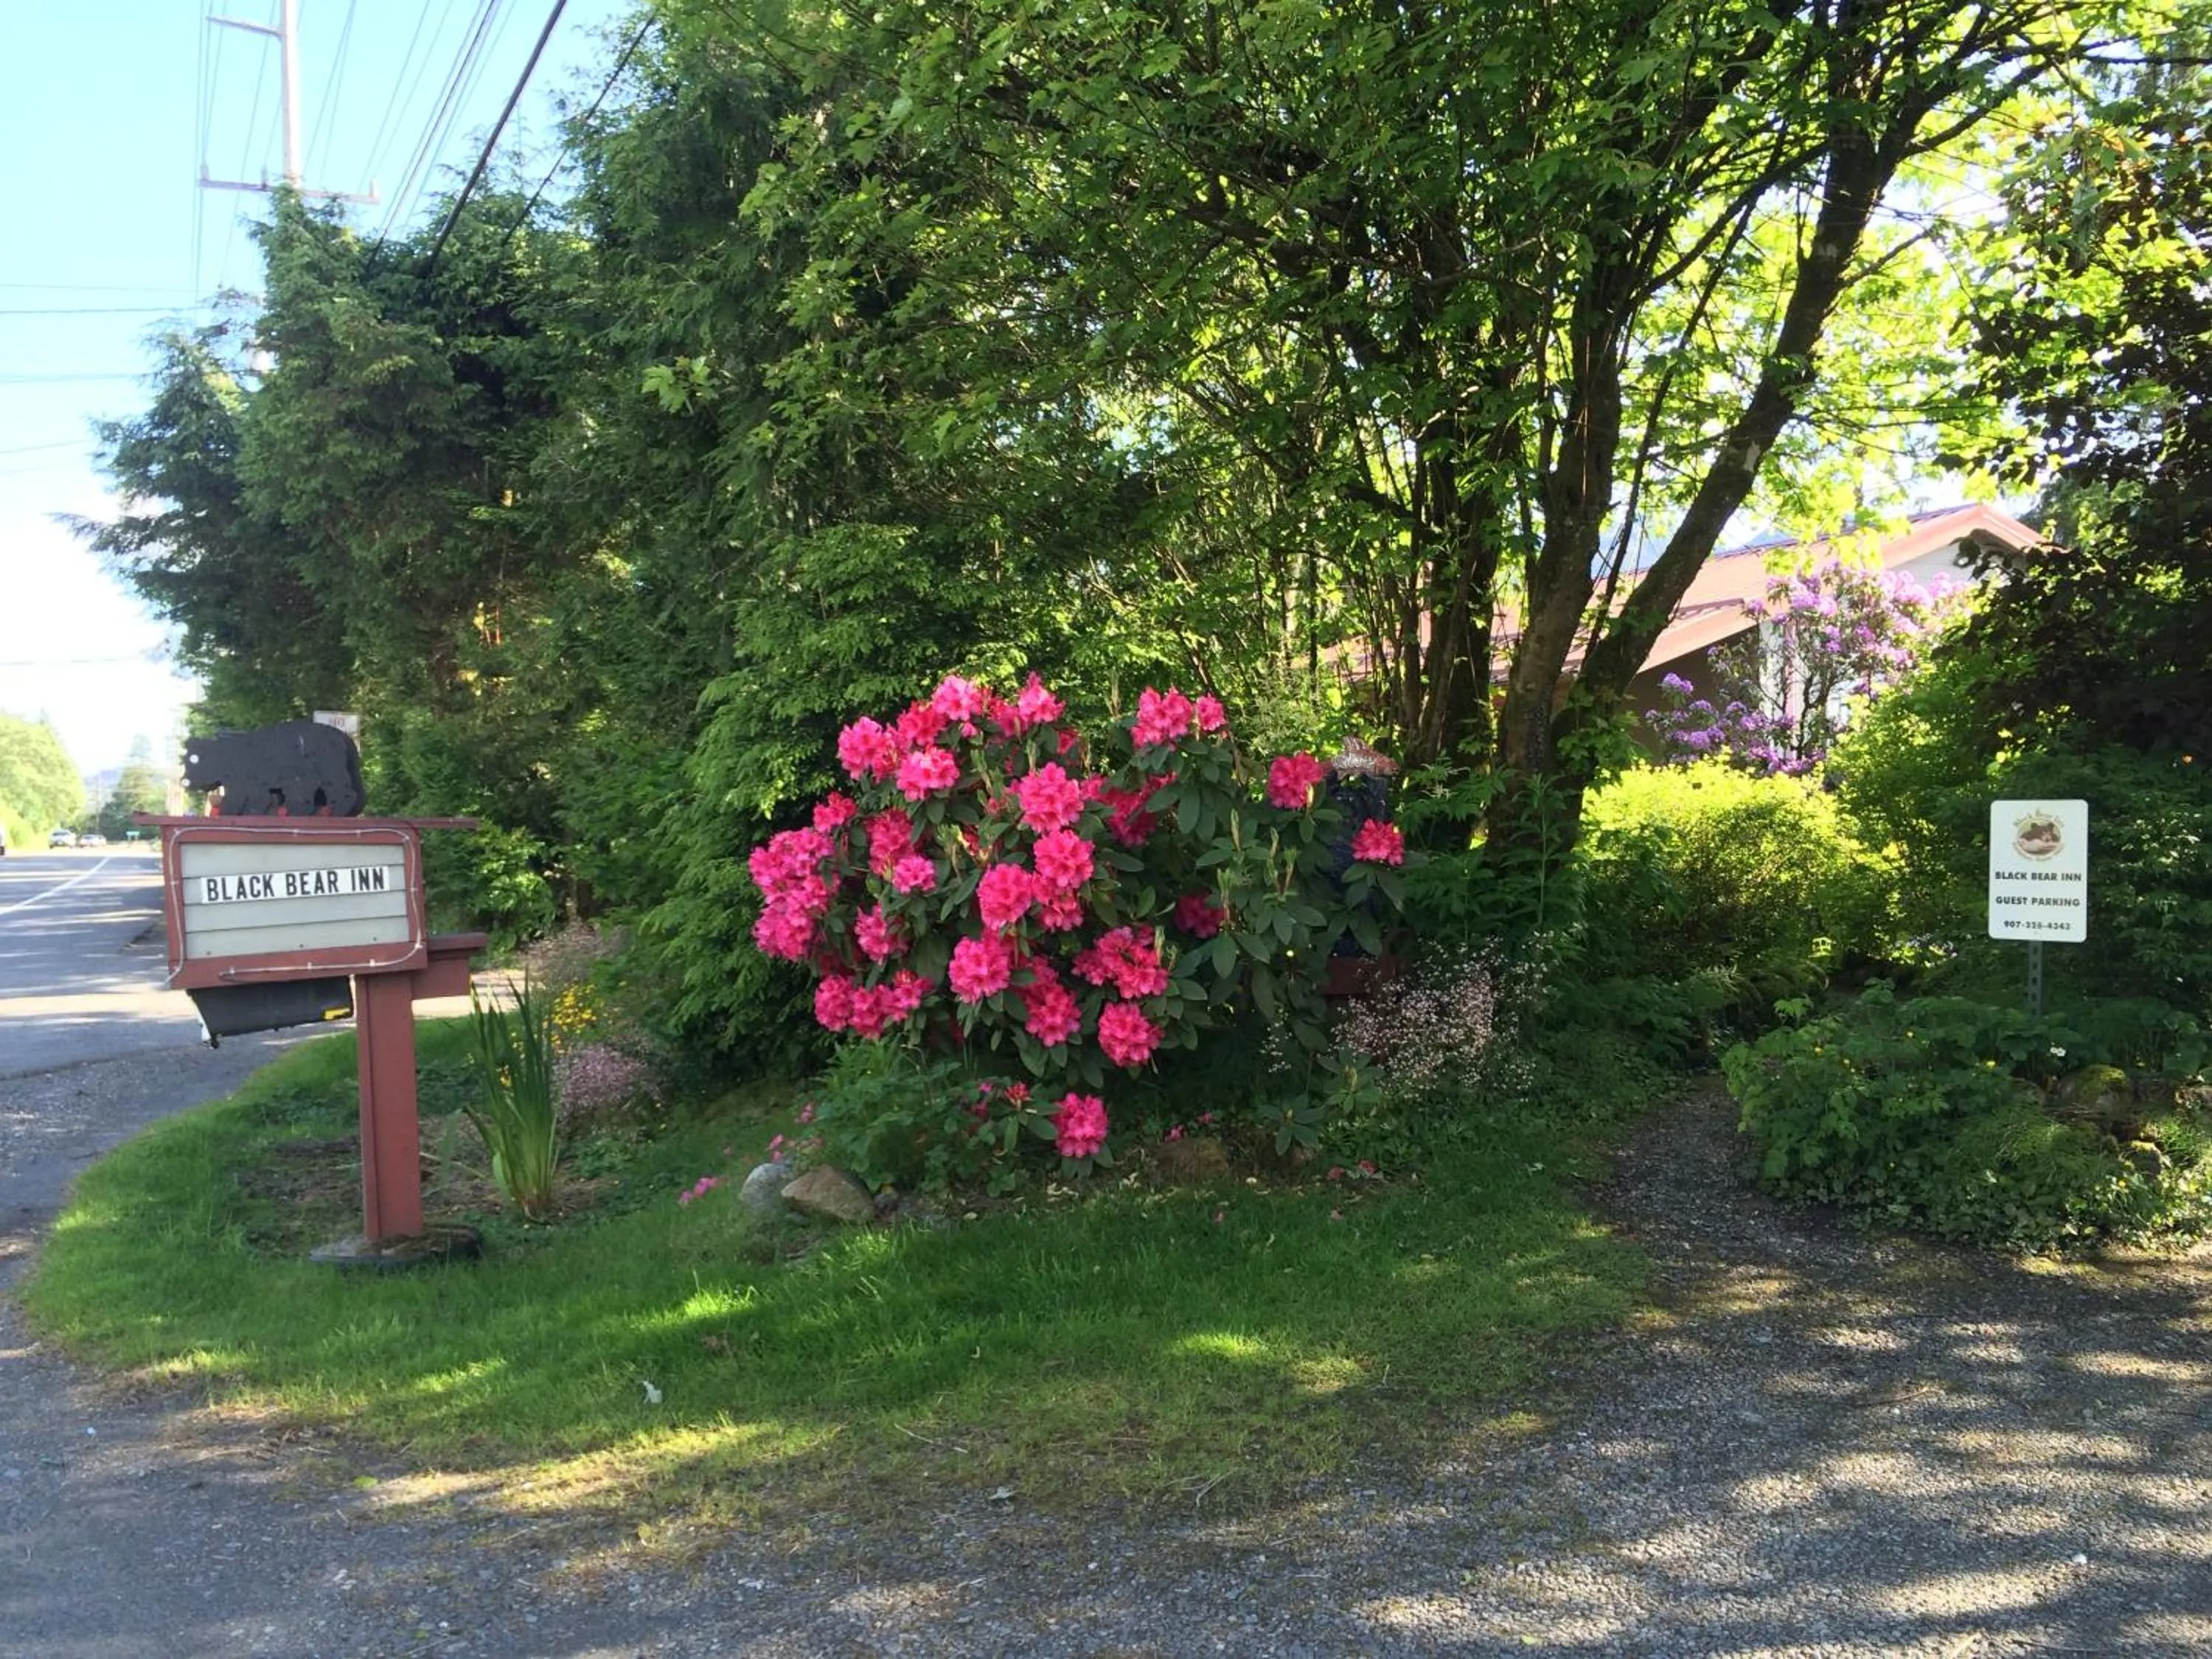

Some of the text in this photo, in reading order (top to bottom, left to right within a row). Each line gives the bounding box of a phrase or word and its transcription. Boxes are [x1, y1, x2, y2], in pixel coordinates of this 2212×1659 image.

[1994, 871, 2081, 881] BLACK BEAR INN
[206, 867, 385, 902] BLACK BEAR INN
[1996, 896, 2081, 907] GUEST PARKING
